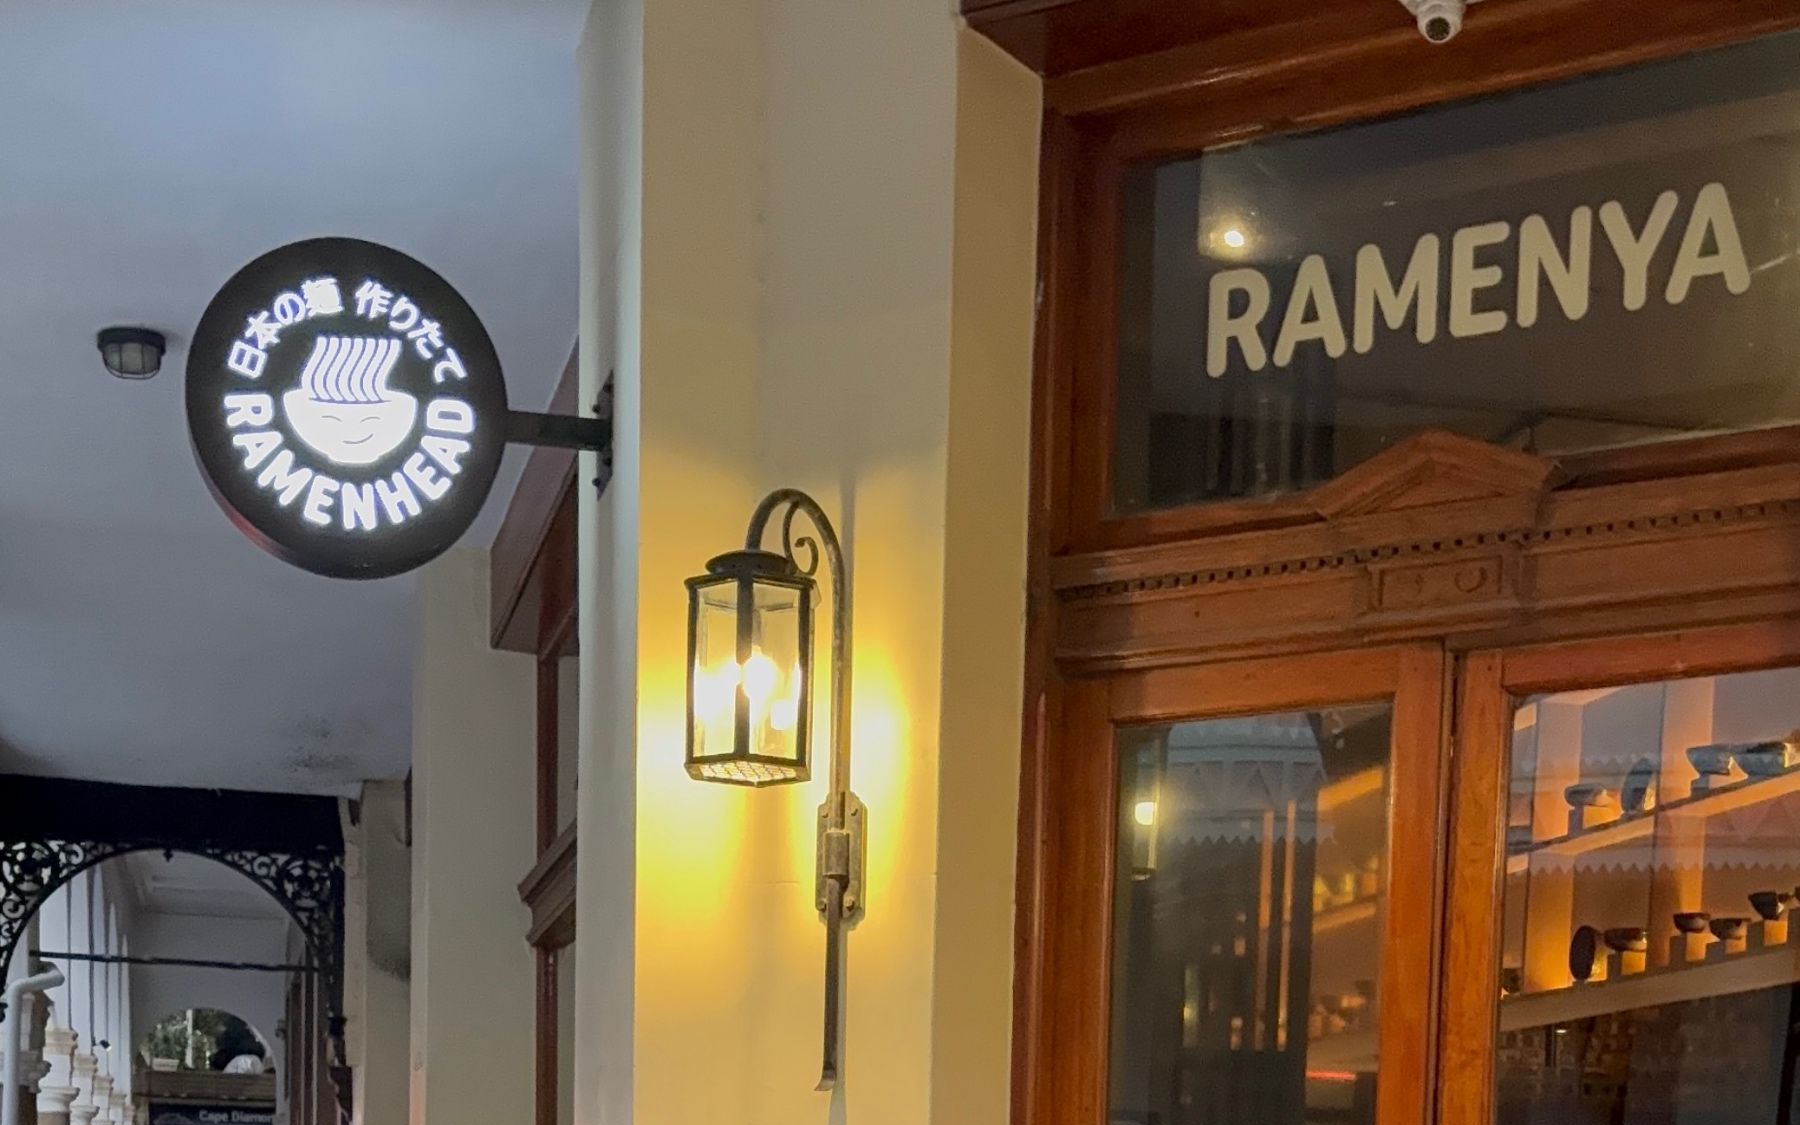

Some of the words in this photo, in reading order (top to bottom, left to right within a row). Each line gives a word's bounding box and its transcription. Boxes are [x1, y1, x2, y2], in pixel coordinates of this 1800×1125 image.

[1206, 182, 1751, 378] RAMENYA
[224, 394, 474, 530] RAMENHEAD
[199, 1110, 229, 1124] Cape
